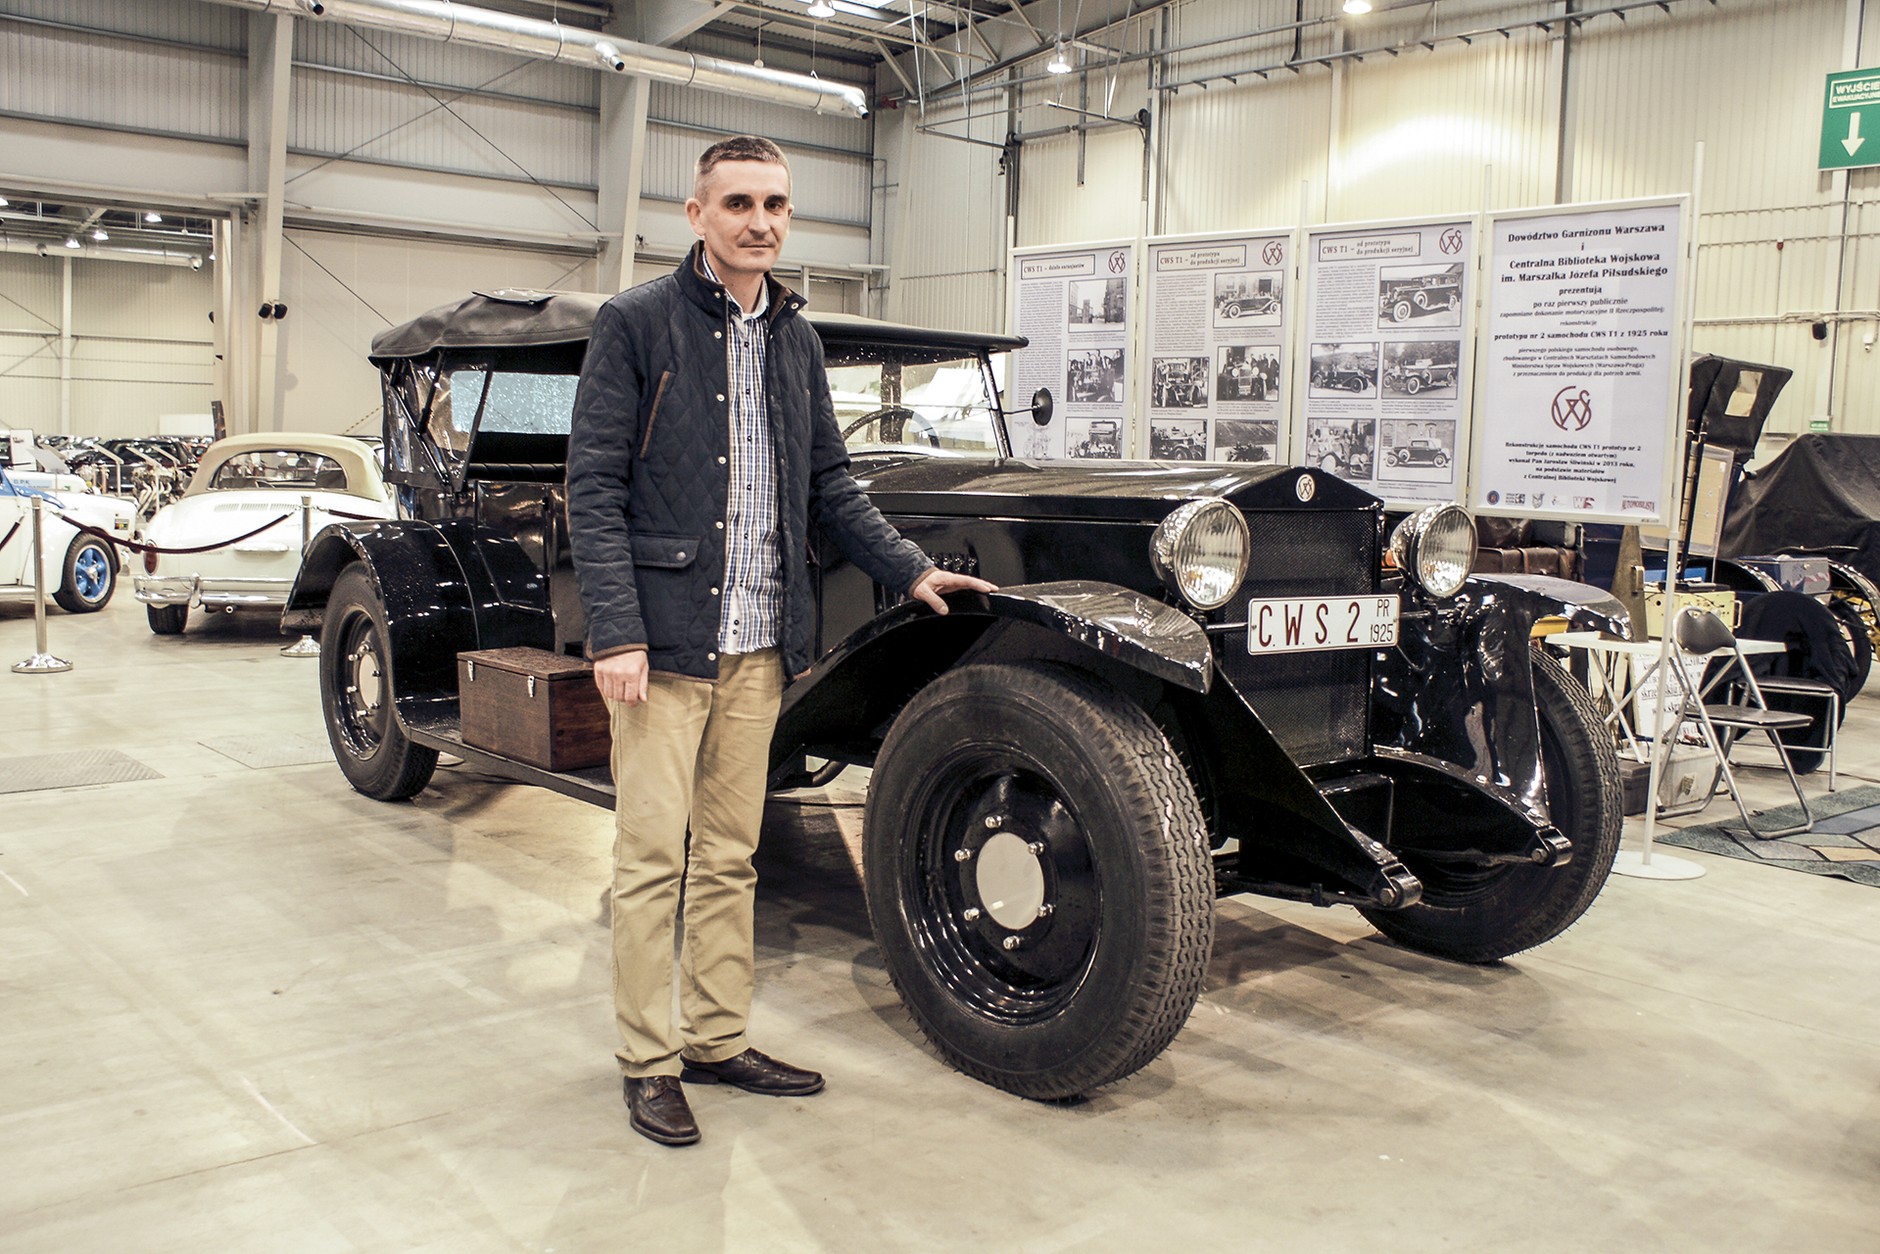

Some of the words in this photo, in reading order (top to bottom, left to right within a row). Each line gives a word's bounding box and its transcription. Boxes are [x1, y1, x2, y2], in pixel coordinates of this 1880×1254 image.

[1508, 232, 1558, 242] Dowództwo
[1561, 228, 1611, 238] Garnizonu
[1615, 224, 1665, 233] Warszawa
[1322, 246, 1337, 254] CWS
[1581, 242, 1585, 251] i
[1510, 259, 1555, 269] Centralna
[1558, 255, 1607, 266] Biblioteka
[1610, 253, 1660, 264] Wojskowa
[1501, 275, 1515, 283] im.
[1569, 268, 1598, 279] Józefa
[1602, 267, 1668, 277] Piłsudskiego
[1590, 298, 1628, 306] publicznie
[1494, 333, 1528, 341] prototypu
[1377, 599, 1389, 617] PR
[1347, 602, 1360, 642] 2
[1370, 624, 1393, 642] 1925
